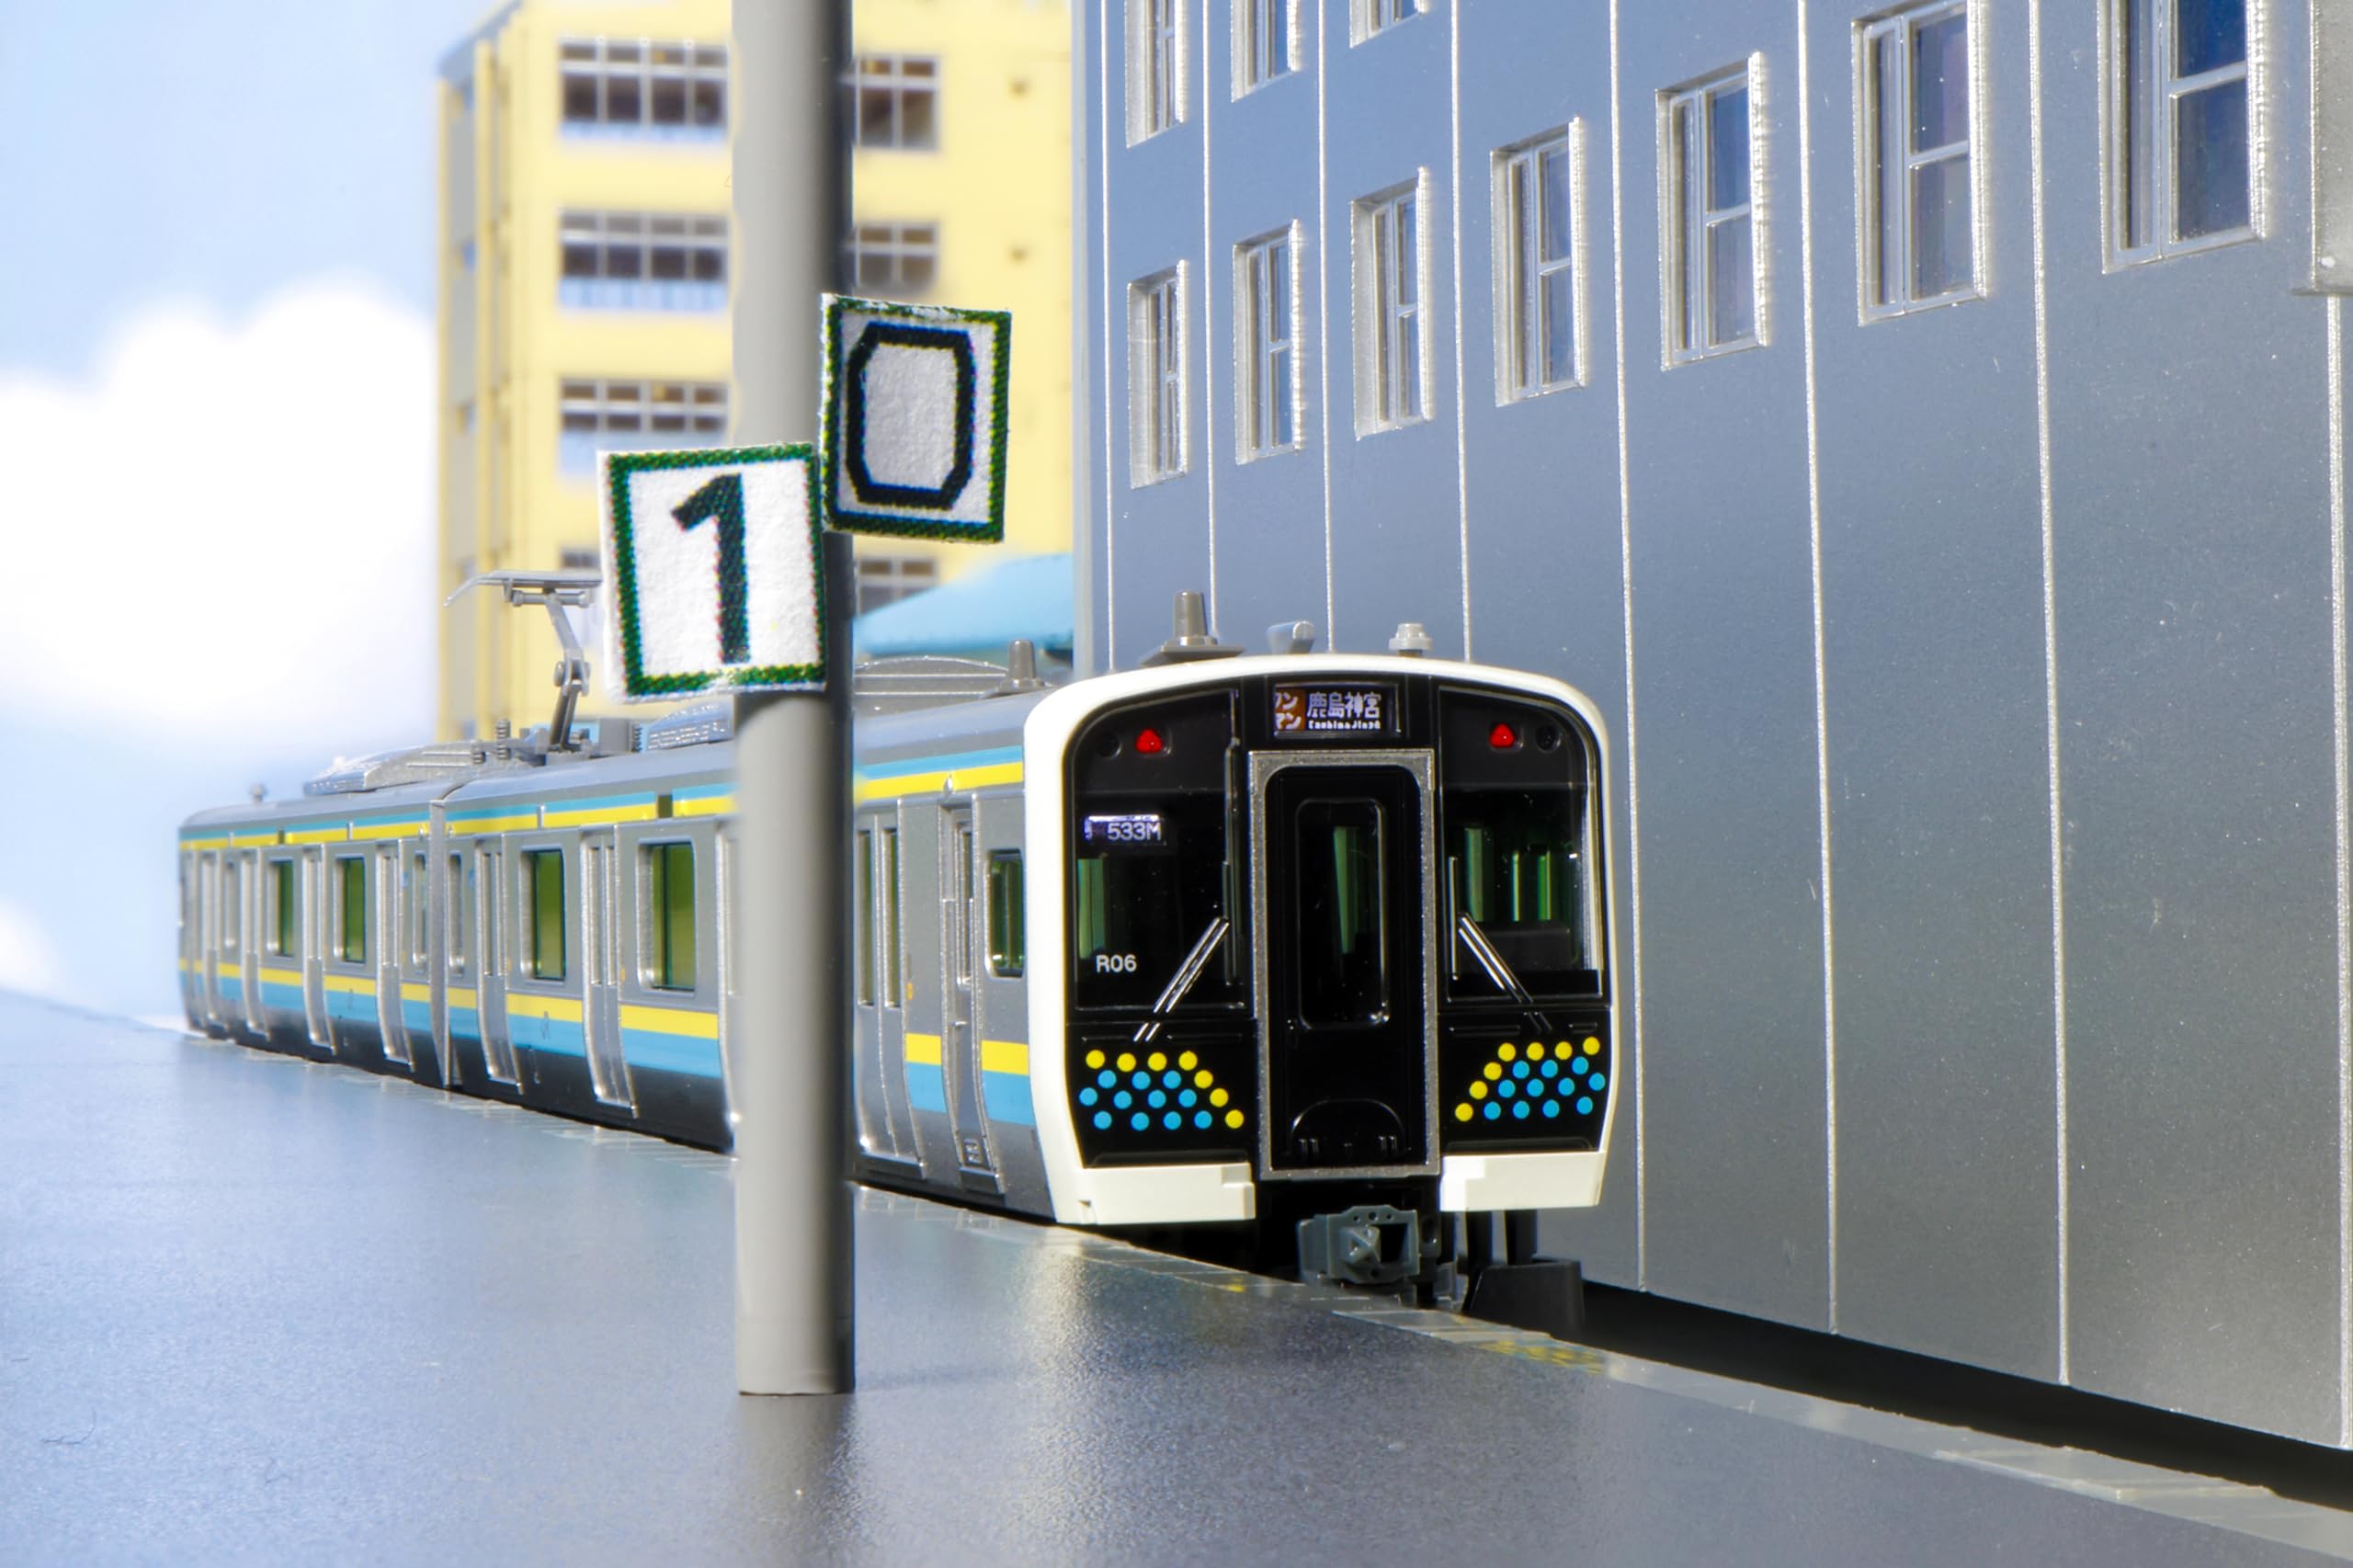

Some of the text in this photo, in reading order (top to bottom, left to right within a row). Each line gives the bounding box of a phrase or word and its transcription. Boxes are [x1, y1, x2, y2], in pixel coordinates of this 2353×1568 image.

[671, 472, 751, 665] 1
[1306, 691, 1381, 719] 鹿島神宮
[1108, 822, 1161, 840] 533M
[1096, 954, 1137, 972] R06
